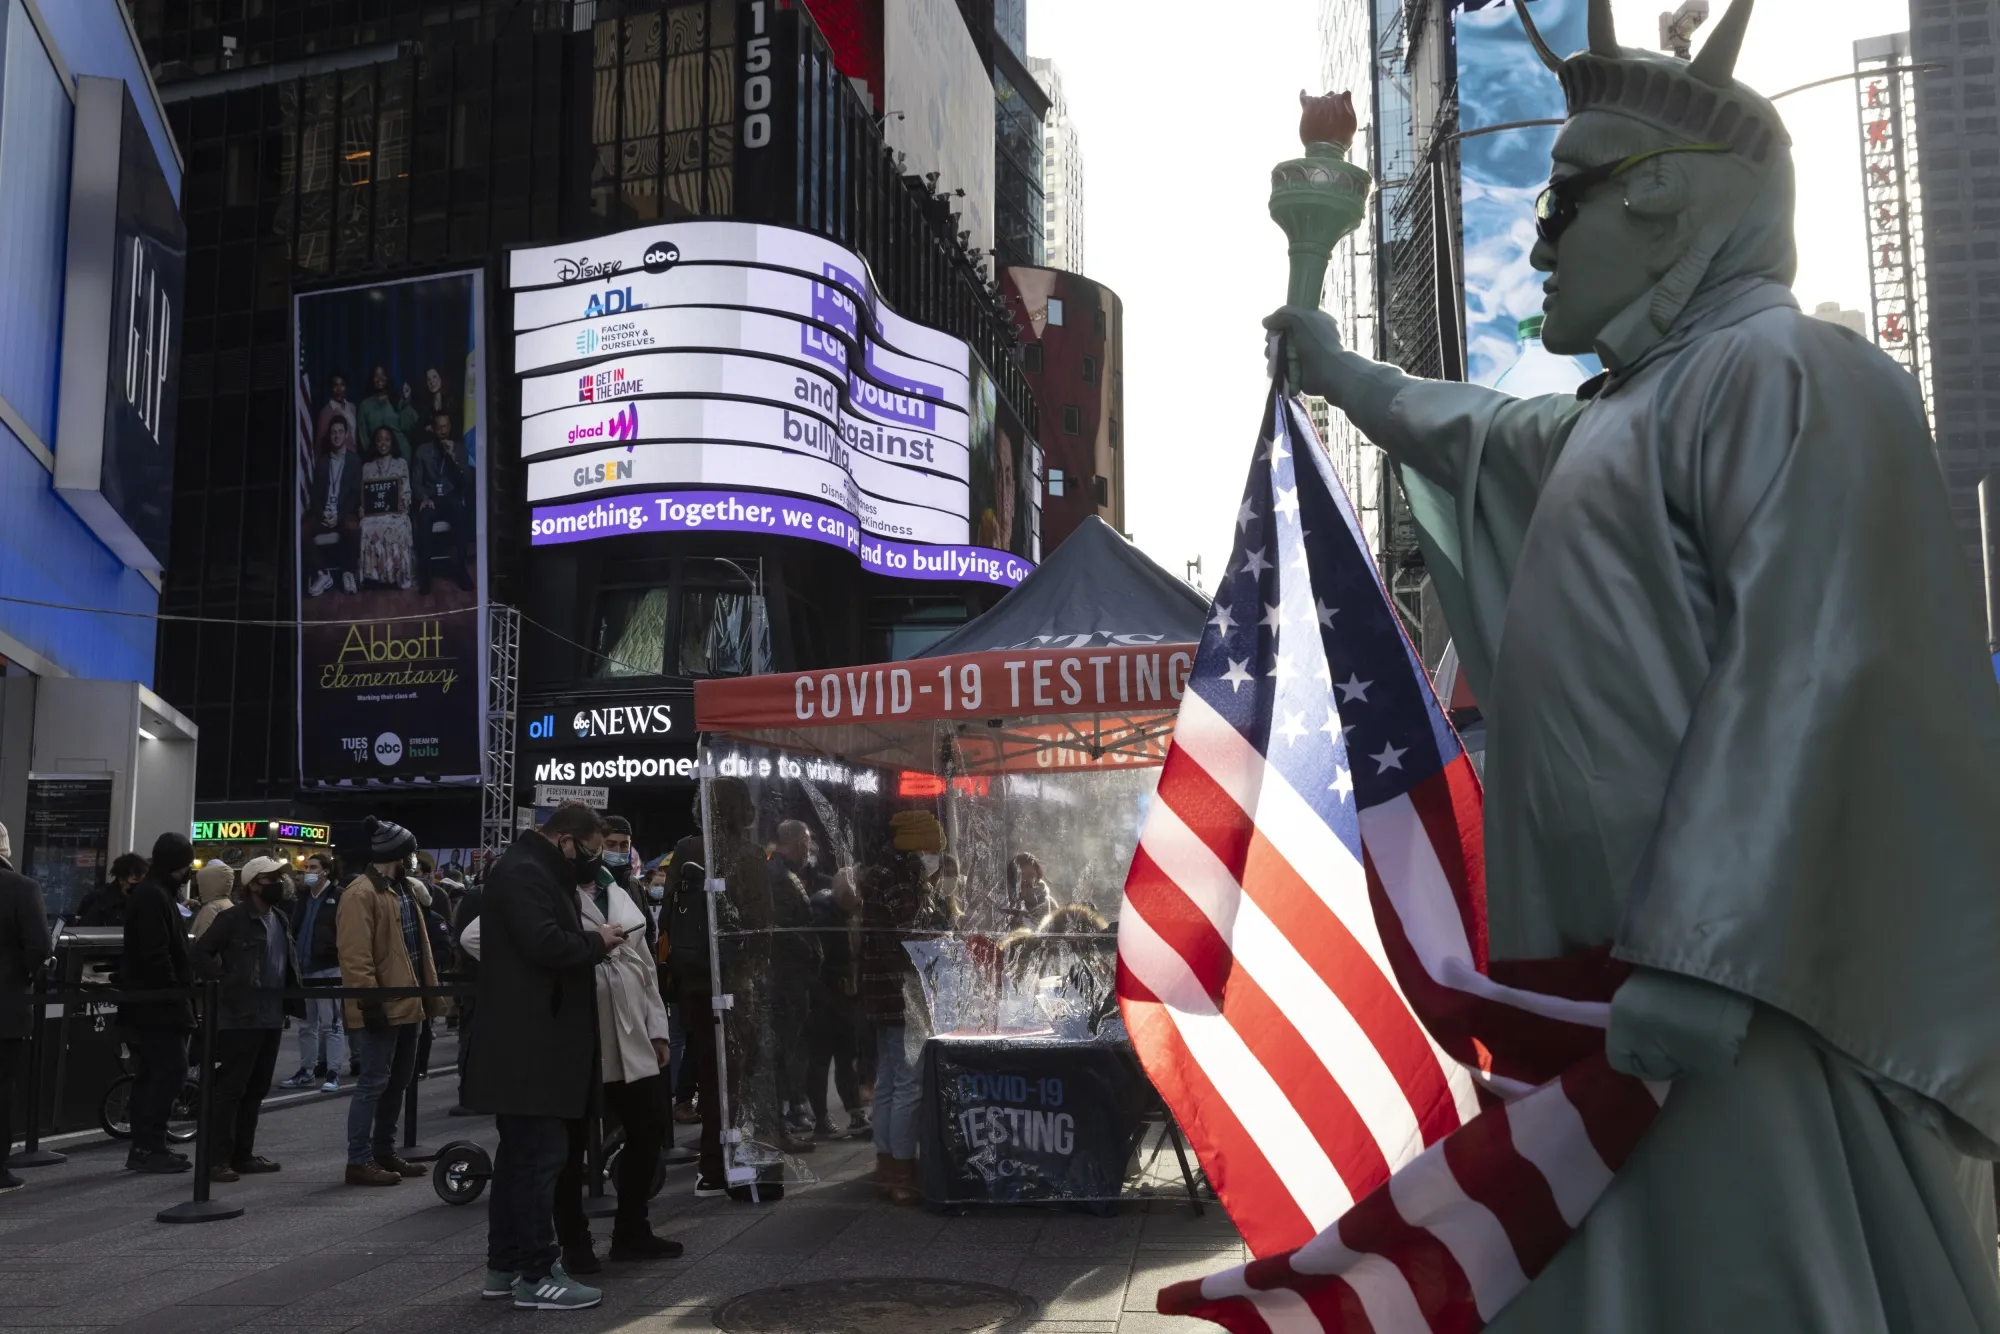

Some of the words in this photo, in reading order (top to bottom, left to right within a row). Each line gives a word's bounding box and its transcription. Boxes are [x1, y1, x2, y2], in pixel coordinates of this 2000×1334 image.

[743, 1, 771, 149] 1500
[645, 250, 678, 264] abc
[584, 286, 643, 318] ADL
[127, 236, 170, 445] GAP
[602, 322, 635, 334] FACING
[602, 331, 641, 343] HISTORY
[602, 337, 656, 351] OURSELVES
[596, 371, 612, 387] GET
[613, 368, 625, 382] IN
[596, 384, 613, 400] THE
[614, 379, 644, 396] GAME
[856, 378, 925, 419] youth
[568, 421, 604, 444] glaad
[794, 377, 834, 413] and
[839, 417, 934, 463] against
[783, 410, 853, 476] bullying,
[573, 460, 633, 487] GLSEN
[370, 483, 391, 492] STAFF
[531, 503, 649, 536] something.
[655, 497, 776, 527] Together,
[783, 508, 813, 527] we
[817, 515, 845, 539] can
[847, 525, 860, 547] pu
[860, 544, 882, 566] end
[886, 550, 907, 569] to
[913, 549, 1004, 581] bullying.
[1007, 559, 1023, 582] Go
[338, 621, 444, 664] Abbott
[320, 662, 458, 694] Elementary
[795, 663, 982, 720] COVID-19
[1003, 651, 1191, 708] TESTING
[357, 694, 380, 702] Working
[381, 693, 394, 701] their
[395, 692, 408, 700] class
[409, 691, 418, 699] off.
[573, 719, 590, 730] abc
[590, 704, 672, 737] NEWS
[341, 737, 368, 750] TUES
[353, 750, 369, 763] 1/4
[376, 742, 401, 754] abc
[409, 745, 439, 757] hulu
[719, 752, 772, 778] due
[777, 755, 800, 779] to
[546, 787, 577, 797] PEDESTRIAN
[577, 788, 592, 797] FLOW
[593, 789, 606, 798] ZONE
[585, 797, 605, 806] MOVING
[218, 822, 257, 838] NOW
[280, 824, 299, 836] HOT
[300, 826, 325, 839] FOOD
[957, 1073, 1064, 1107] COVID-19
[958, 1105, 1075, 1155] TESTING
